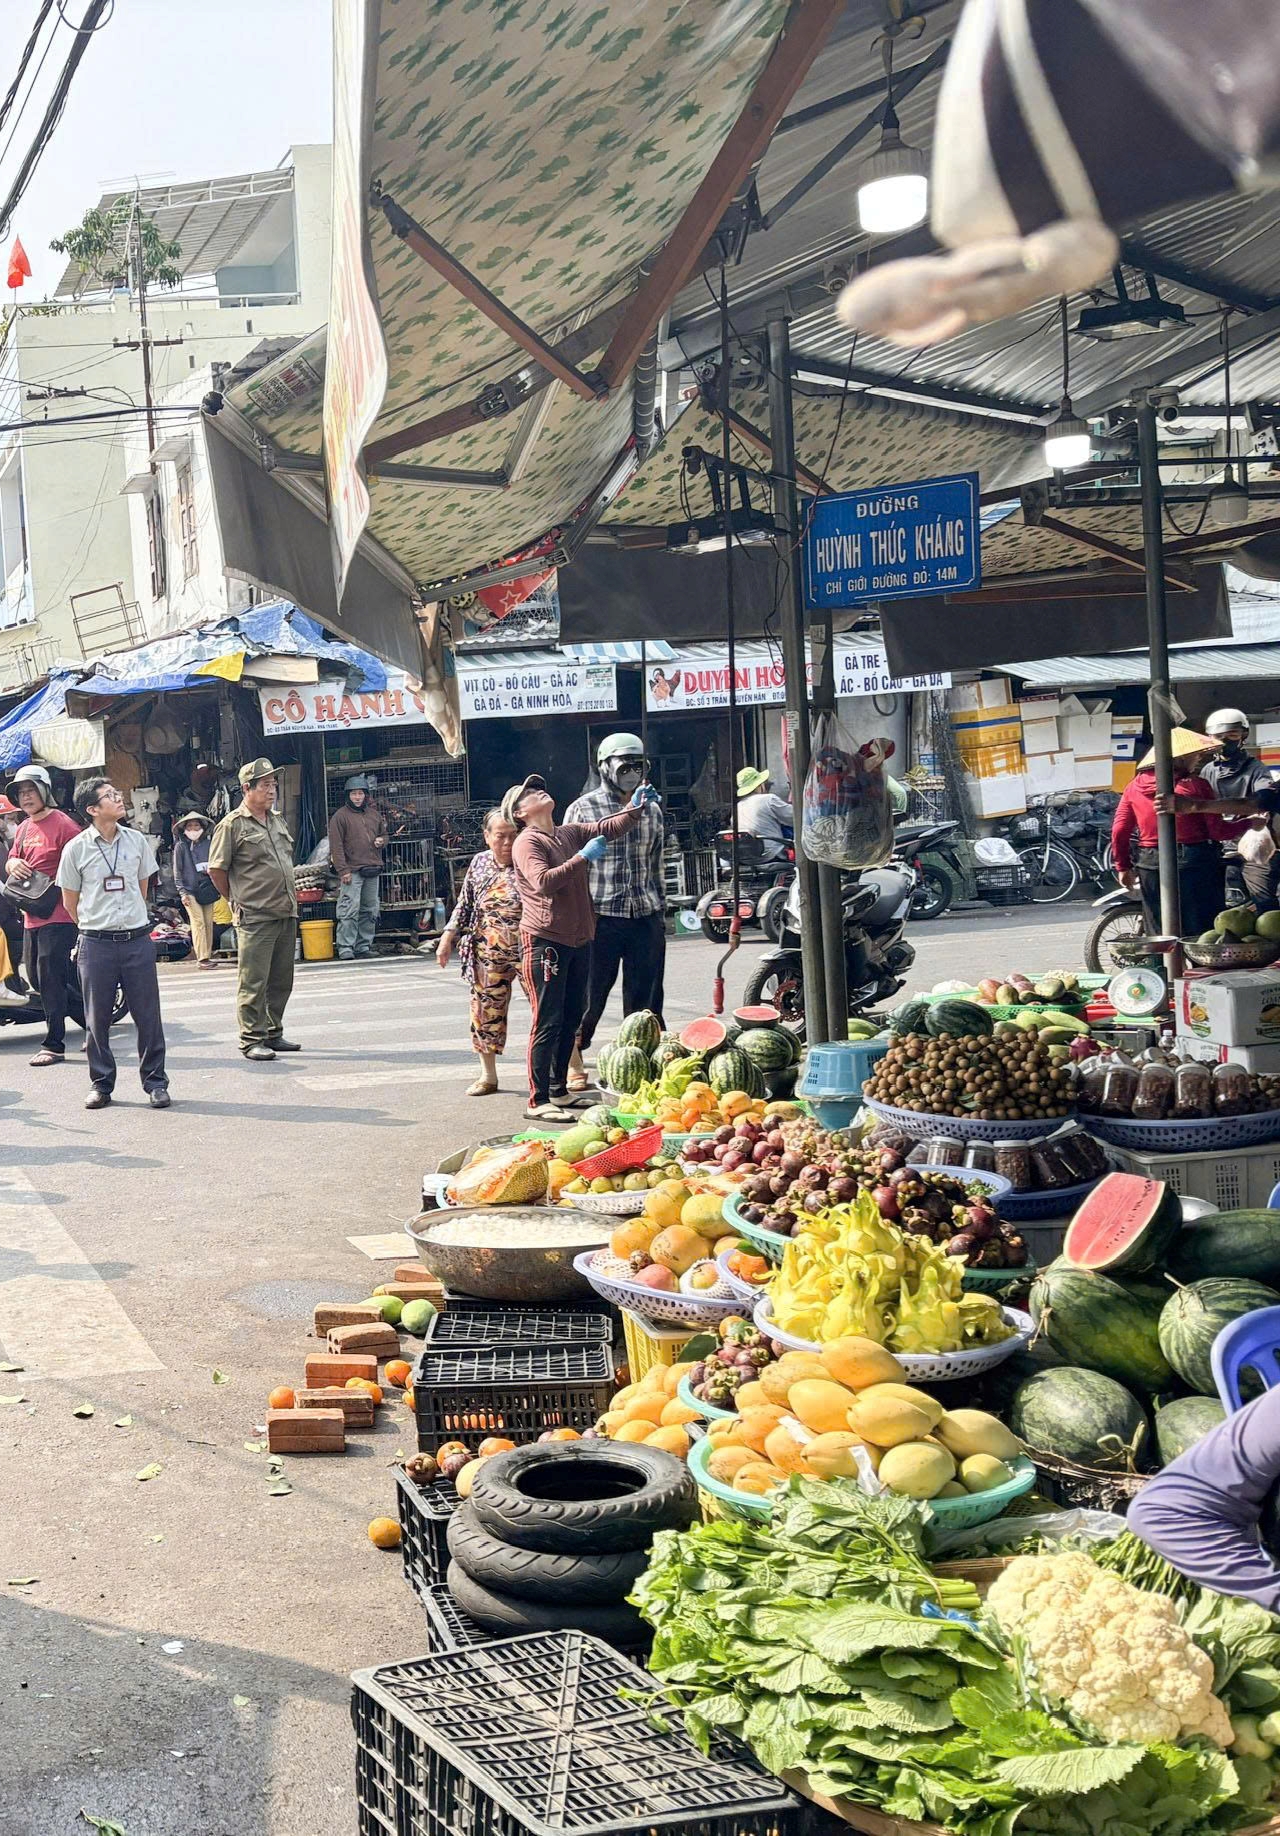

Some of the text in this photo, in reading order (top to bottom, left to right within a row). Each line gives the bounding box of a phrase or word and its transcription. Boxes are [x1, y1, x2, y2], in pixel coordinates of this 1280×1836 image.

[856, 495, 919, 518] ĐƯỜNG
[816, 514, 964, 573] HUỲNH THÚC KHÁNG
[848, 575, 867, 592] GIỚI
[873, 571, 907, 589] ĐƯỜNG
[936, 566, 958, 581] 14M
[861, 654, 880, 669] TRE
[464, 678, 478, 696] VỊT
[550, 670, 563, 688] GÀ
[566, 670, 578, 687] ÁC
[840, 676, 854, 694] ÁC
[265, 689, 306, 724] CÔ
[314, 689, 407, 728] HẠNH
[474, 694, 487, 711] GÀ
[489, 694, 502, 710] ĐÁ
[511, 692, 524, 710] GÀ
[526, 694, 549, 709] NINH
[552, 690, 572, 707] HÒA
